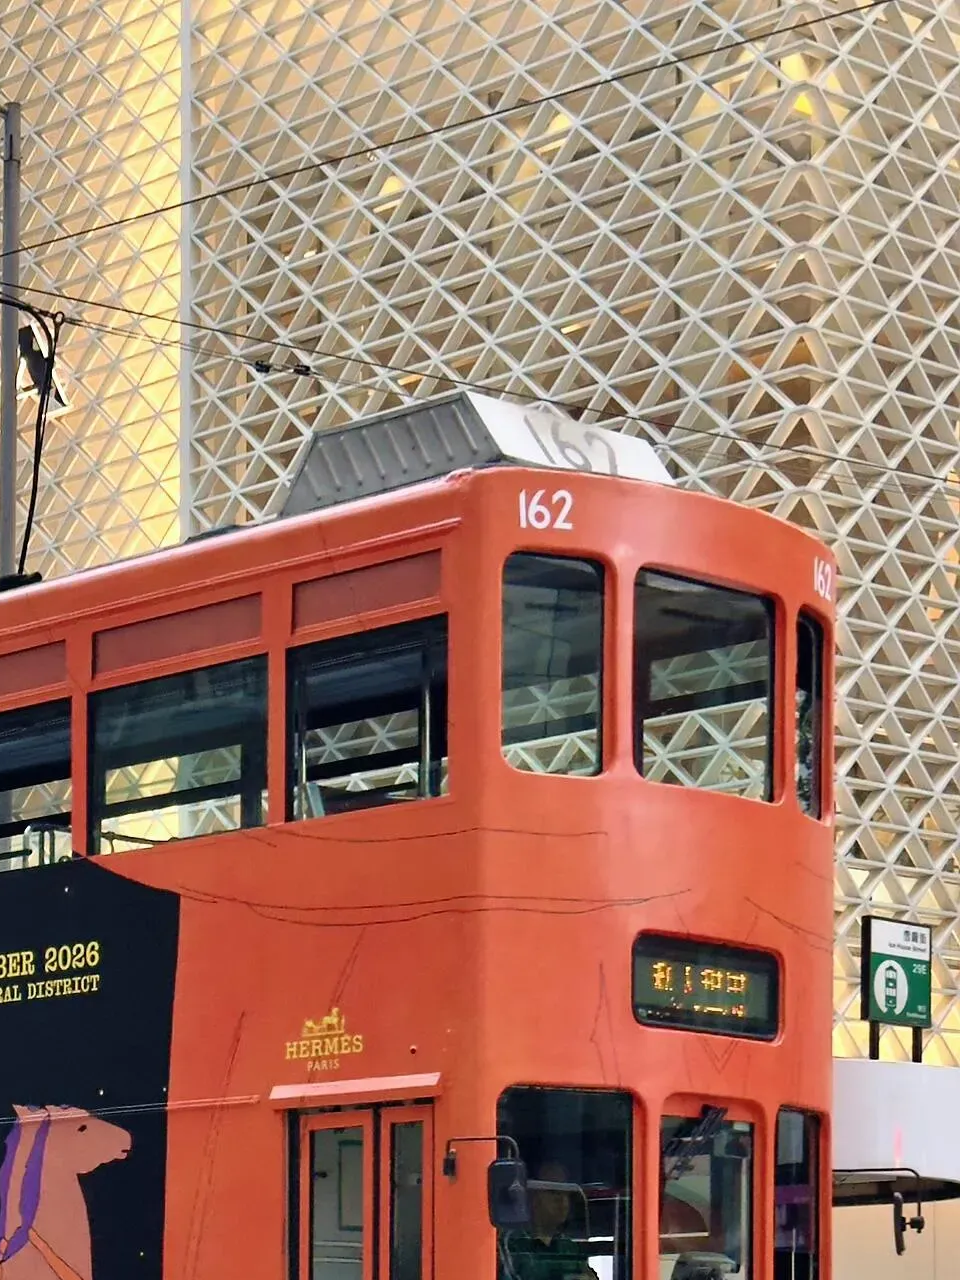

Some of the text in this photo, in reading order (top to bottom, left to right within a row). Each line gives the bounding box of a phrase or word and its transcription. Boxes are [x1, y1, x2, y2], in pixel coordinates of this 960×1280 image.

[518, 489, 573, 530] 162
[812, 556, 833, 602] 162
[44, 941, 100, 973] 2026
[27, 974, 100, 1000] DISTRICT
[306, 1058, 340, 1072] PARIS
